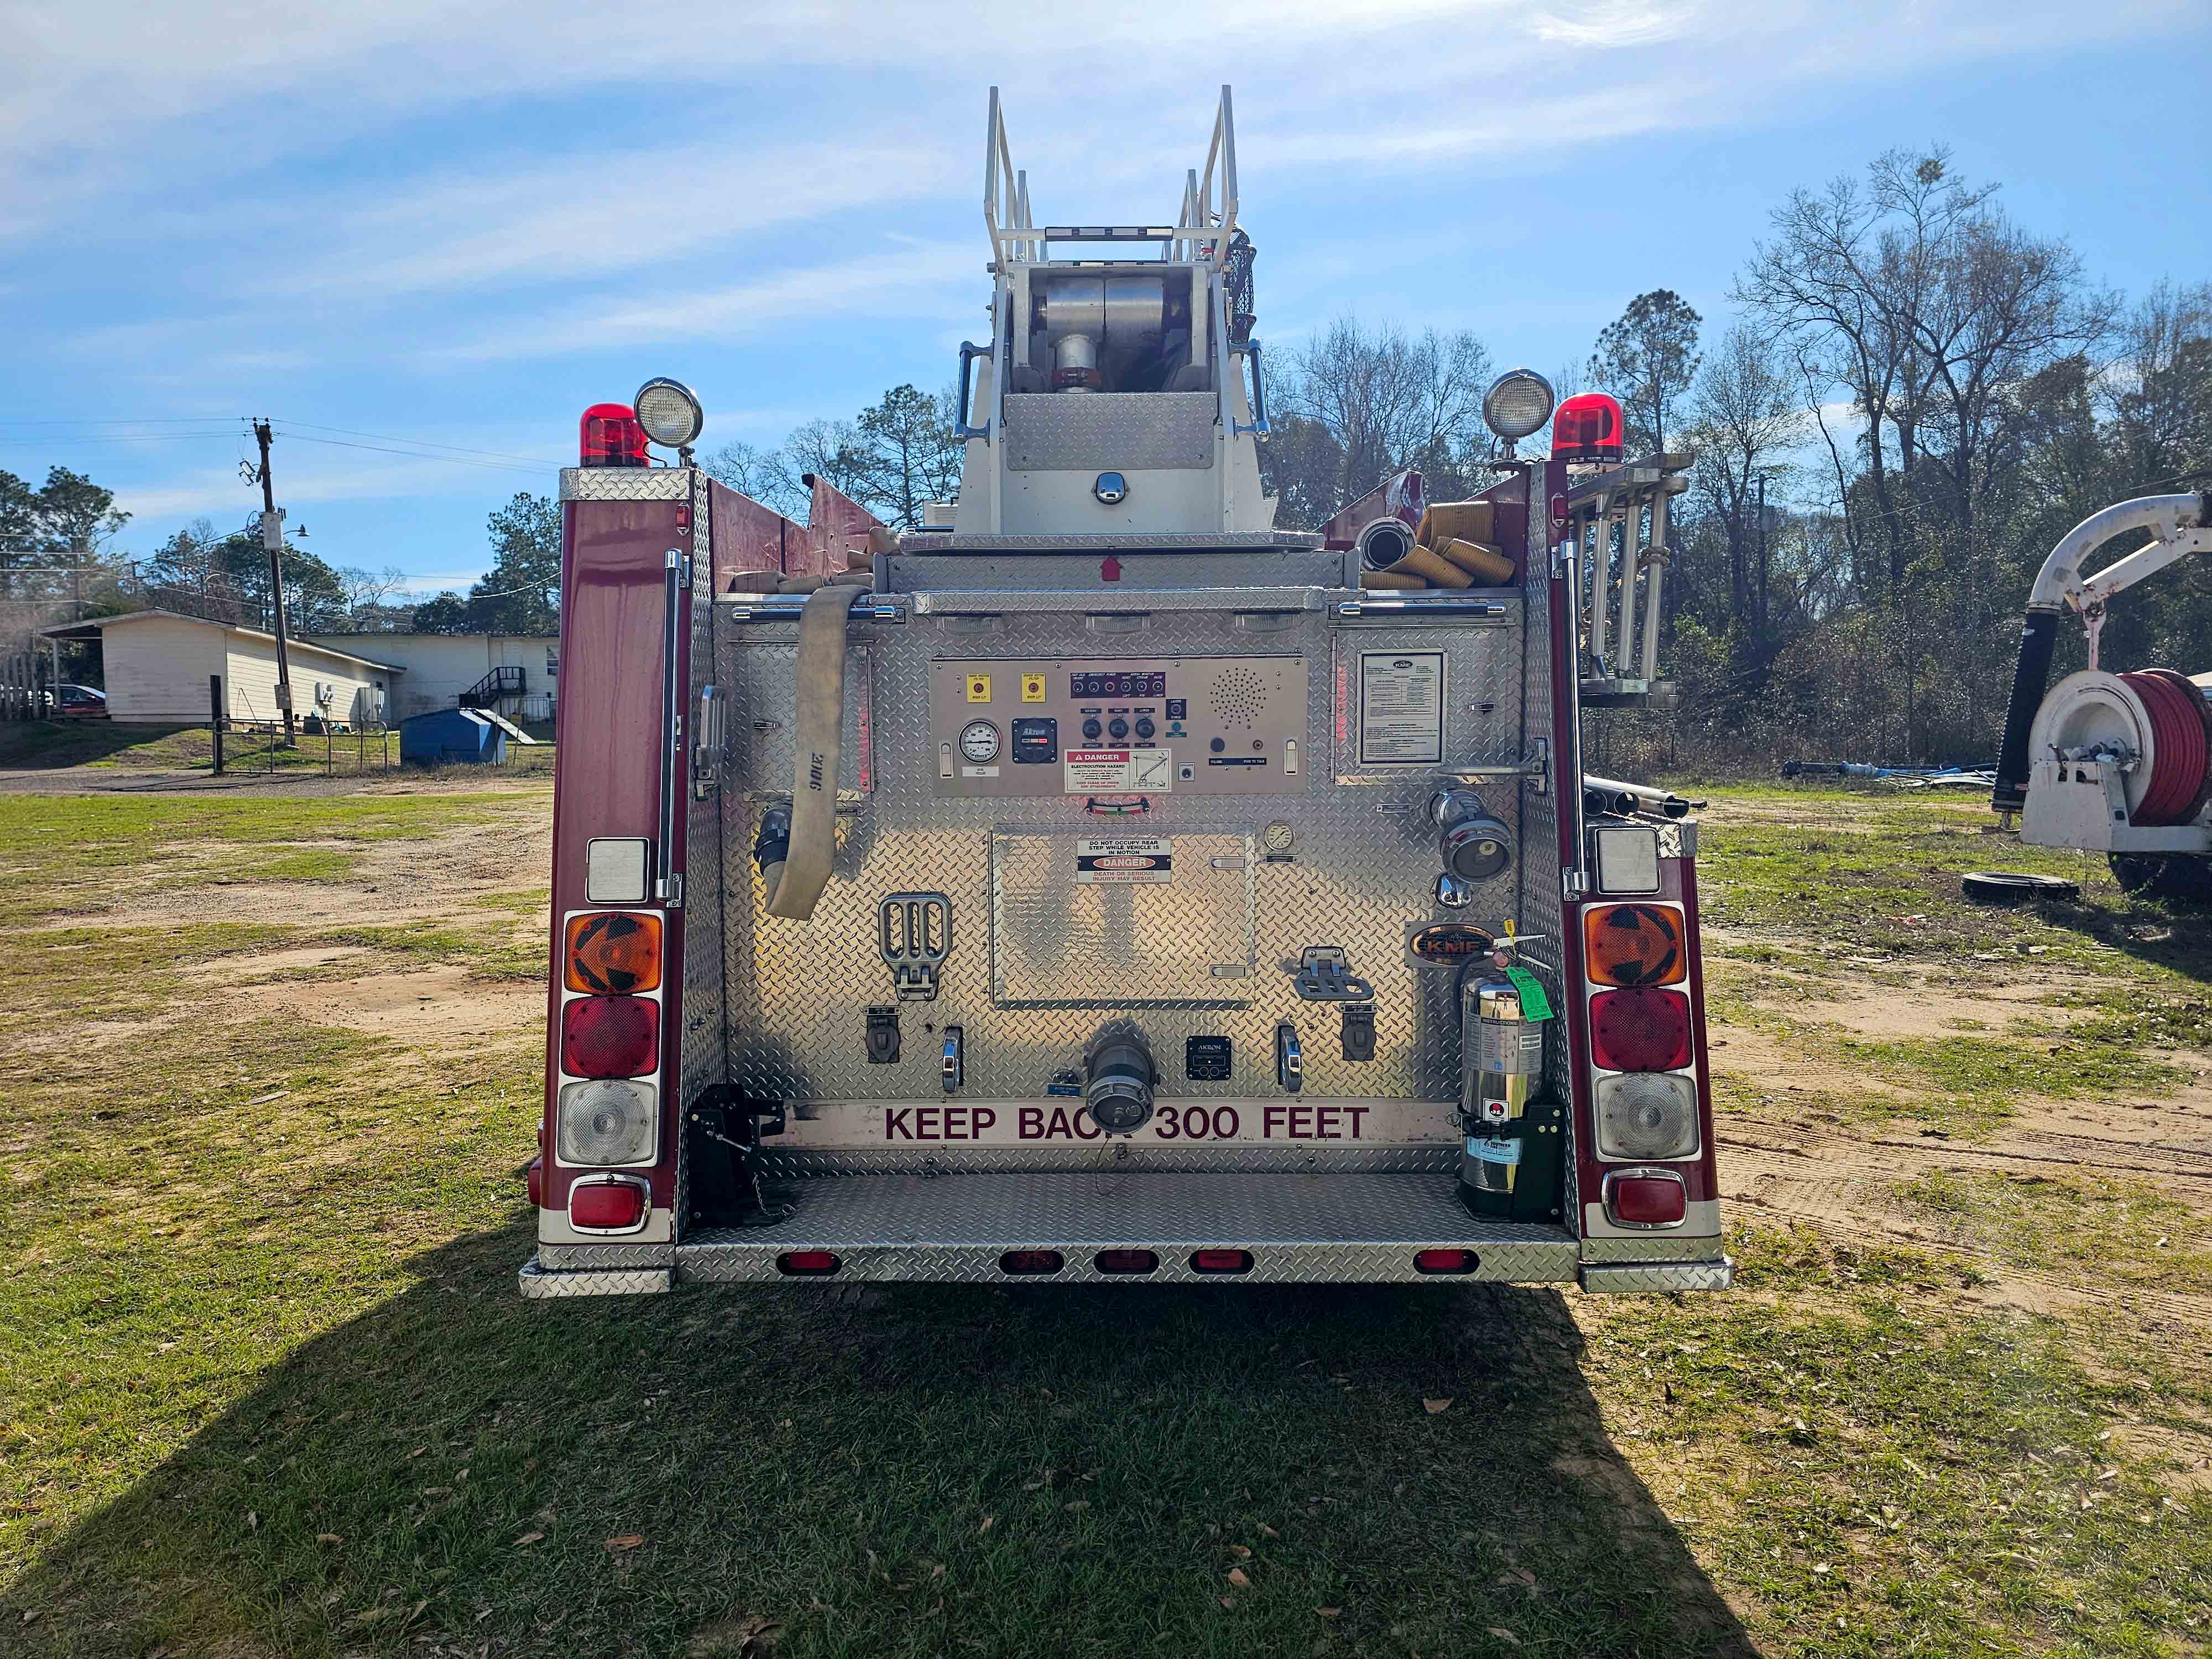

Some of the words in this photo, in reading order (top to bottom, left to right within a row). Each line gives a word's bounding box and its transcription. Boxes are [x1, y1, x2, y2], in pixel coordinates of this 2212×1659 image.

[886, 1108, 996, 1140] KEEP
[1019, 1107, 1133, 1140] BAC
[1155, 1106, 1240, 1139] 300
[1264, 1106, 1370, 1139] FEET
